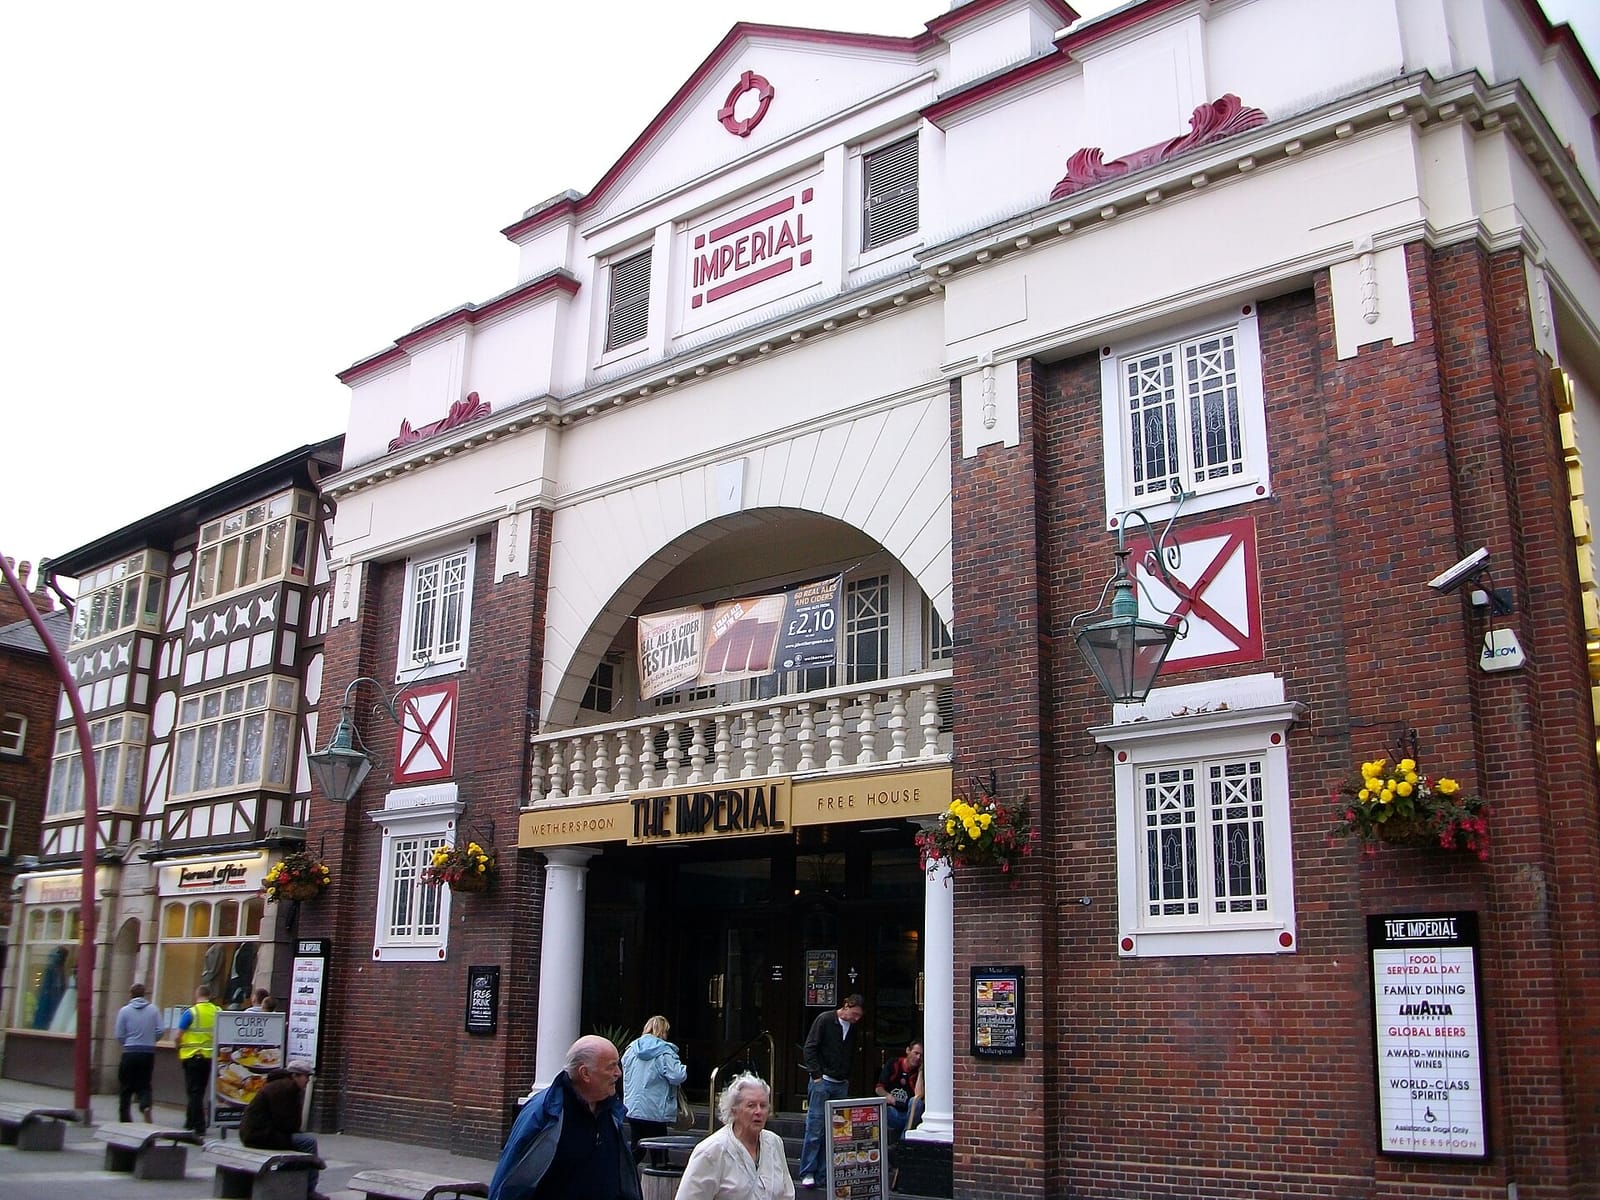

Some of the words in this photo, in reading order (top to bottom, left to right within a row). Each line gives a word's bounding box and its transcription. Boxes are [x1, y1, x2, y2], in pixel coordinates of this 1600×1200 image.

[693, 213, 812, 288] IMPERIAL
[803, 587, 819, 597] REAL
[821, 584, 837, 593] ALES
[795, 597, 810, 606] AND
[811, 592, 834, 603] CIDERS
[788, 609, 835, 636] £2.10
[657, 632, 669, 648] ALE
[671, 628, 677, 641] &
[679, 619, 699, 638] CIDER
[642, 634, 698, 680] FESTIVAL
[531, 818, 614, 836] WETHERSPOON
[630, 796, 671, 838] THE
[675, 786, 785, 834] IMPERIAL
[818, 795, 854, 810] FREE
[867, 788, 920, 805] HOUSE
[1385, 923, 1406, 937] THE
[1407, 921, 1458, 937] IMPERIAL
[1410, 955, 1436, 964] FOOD
[1387, 966, 1420, 975] SERVED
[1423, 966, 1438, 974] ALL
[1441, 965, 1460, 974] DAY
[473, 989, 492, 998] FREE
[1384, 985, 1421, 995] FAMILY
[1425, 985, 1465, 995] DINING
[1399, 1000, 1453, 1015] LAVAZZA
[234, 1016, 269, 1027] CURRY
[238, 1027, 265, 1038] CLUB
[1389, 1027, 1431, 1037] GLOBAL
[1435, 1027, 1466, 1037] BEERS
[1414, 1060, 1442, 1069] WINES
[1411, 1090, 1448, 1100] SPIRITS
[1452, 1126, 1469, 1134] Only
[1390, 1137, 1476, 1148] WETHERSPOON
